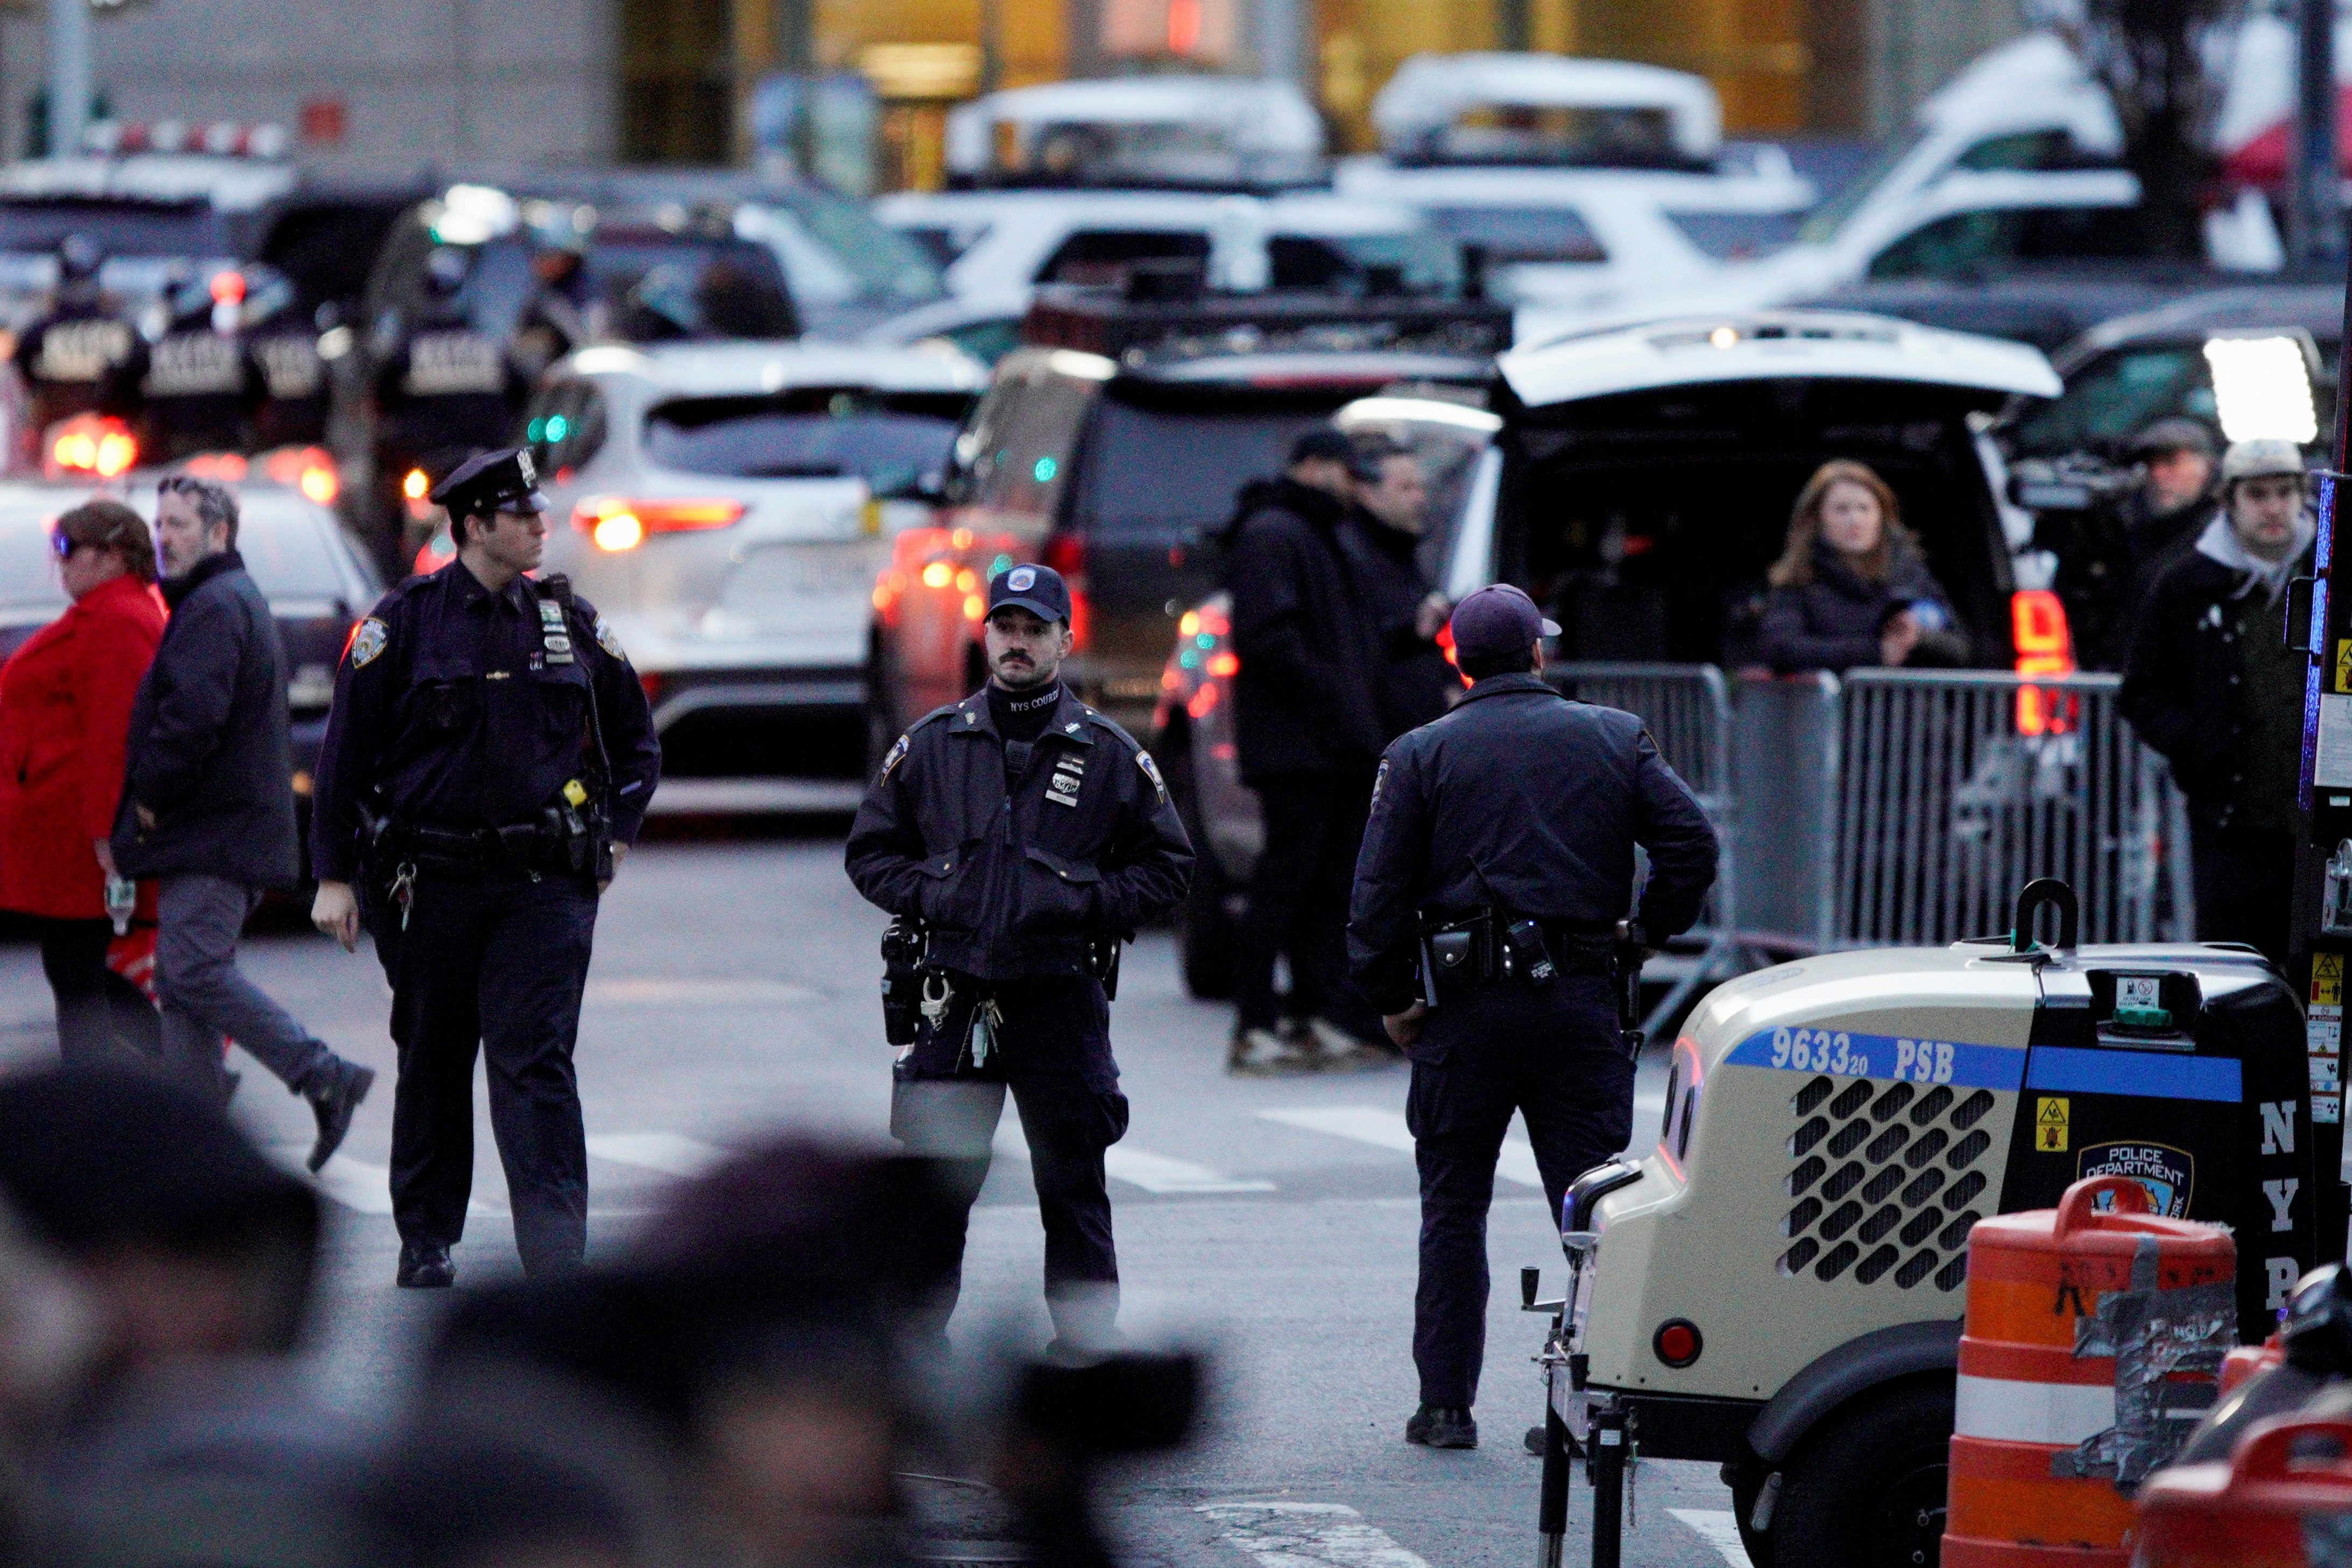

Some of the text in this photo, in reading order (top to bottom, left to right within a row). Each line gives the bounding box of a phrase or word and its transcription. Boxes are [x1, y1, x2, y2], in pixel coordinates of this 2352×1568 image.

[1010, 702, 1029, 711] NYS
[1771, 1026, 1850, 1075] 9633
[1894, 1039, 1954, 1084] PSB
[2109, 1147, 2163, 1164] POLICE
[2086, 1161, 2185, 1186] DEPARTMENT
[2170, 1195, 2184, 1219] ORK
[2260, 1100, 2300, 1311] NYP
